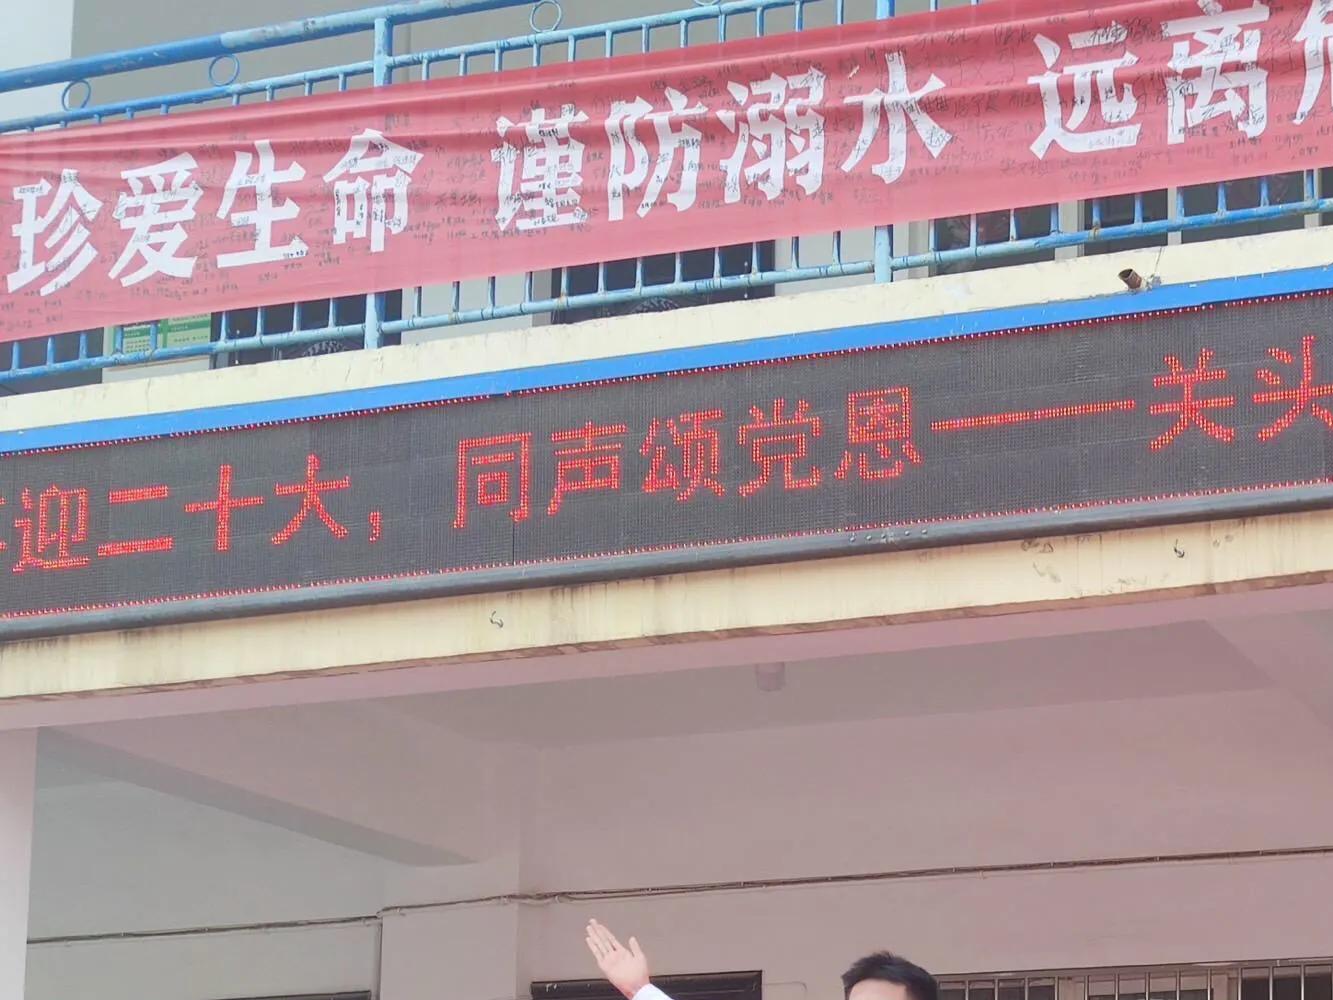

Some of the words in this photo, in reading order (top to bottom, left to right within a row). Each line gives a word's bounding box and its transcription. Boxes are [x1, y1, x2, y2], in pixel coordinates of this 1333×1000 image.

[7, 128, 424, 296] 珍爱生命
[491, 52, 953, 230] 谨防溺水
